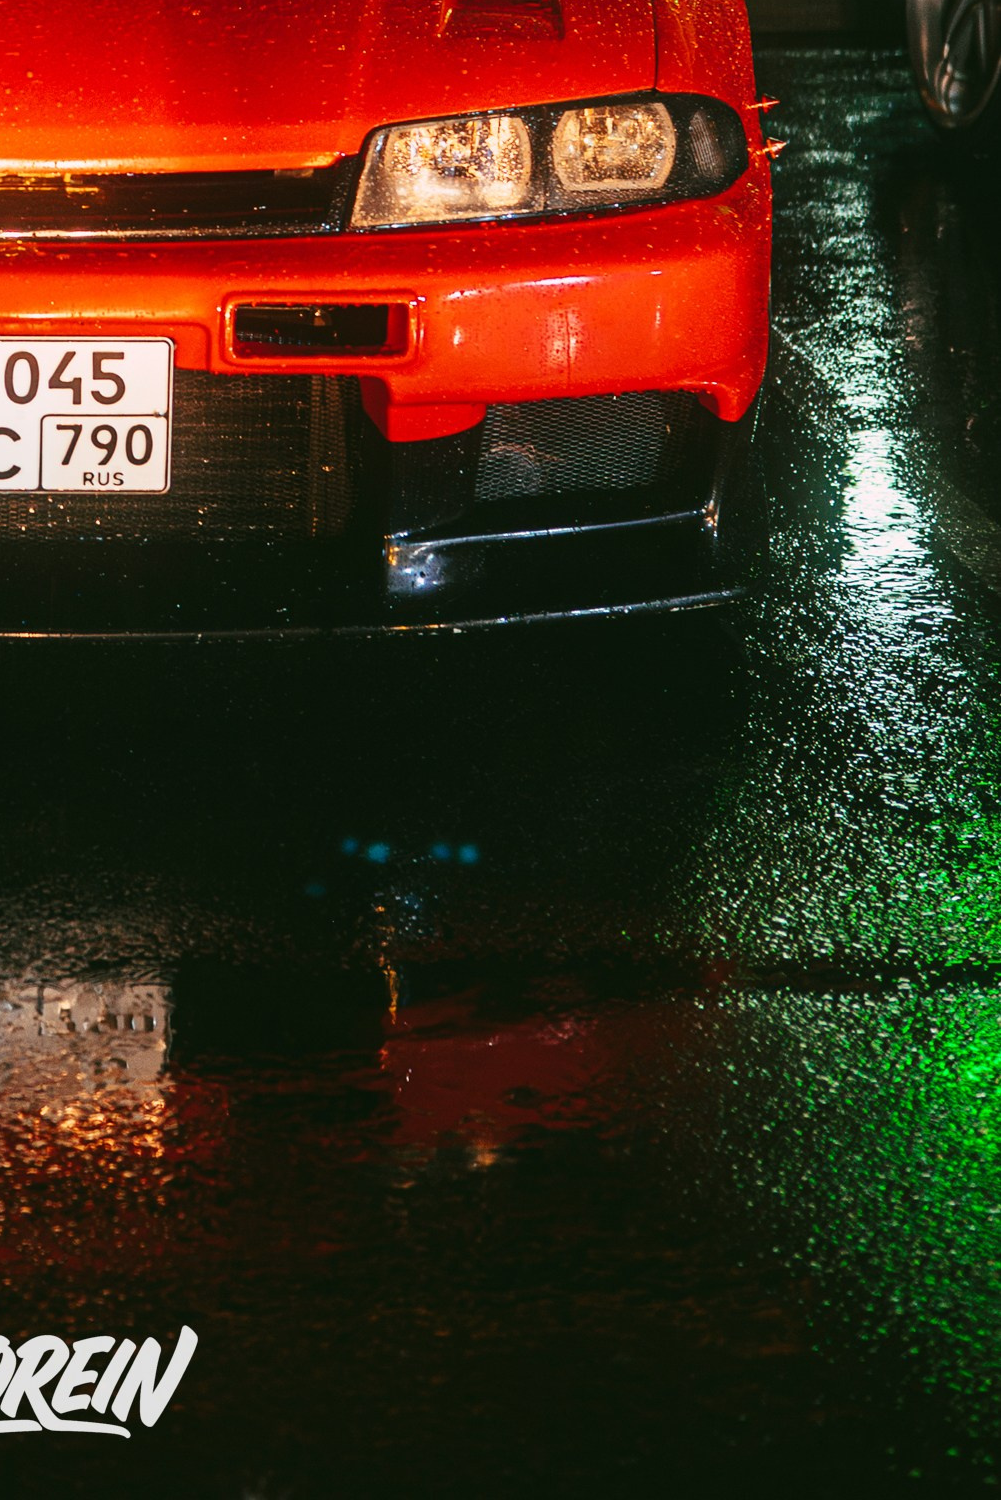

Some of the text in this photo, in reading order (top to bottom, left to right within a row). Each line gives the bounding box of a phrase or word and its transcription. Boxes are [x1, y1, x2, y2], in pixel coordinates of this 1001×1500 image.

[3, 350, 126, 406] 045
[55, 423, 154, 467] 790
[82, 471, 125, 487] RUS
